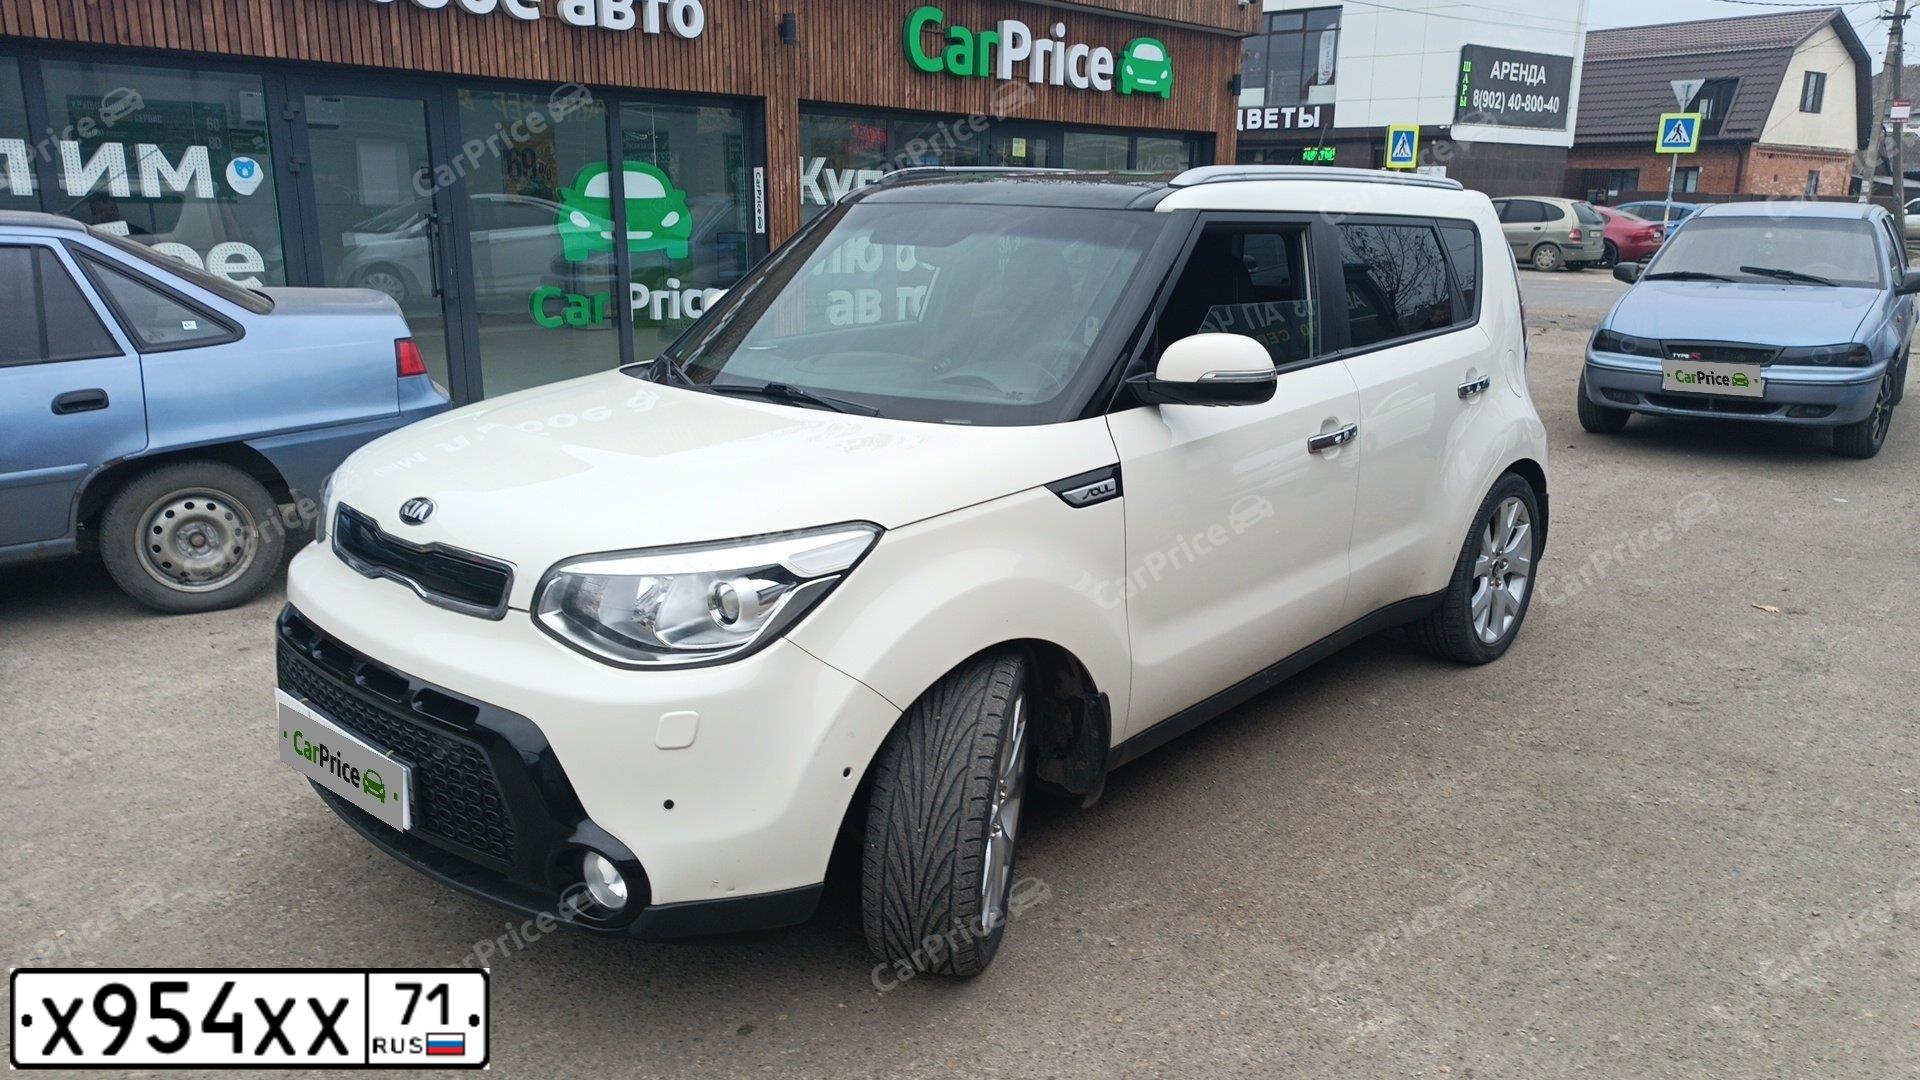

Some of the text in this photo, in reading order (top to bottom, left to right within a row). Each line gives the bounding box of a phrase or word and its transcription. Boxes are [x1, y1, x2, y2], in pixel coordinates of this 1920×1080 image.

[903, 6, 1114, 91] CarPrice
[1460, 61, 1472, 107] ШАРЫ
[1490, 61, 1546, 86] АРЕНДА
[1473, 89, 1560, 114] 8(902) 40-800-40
